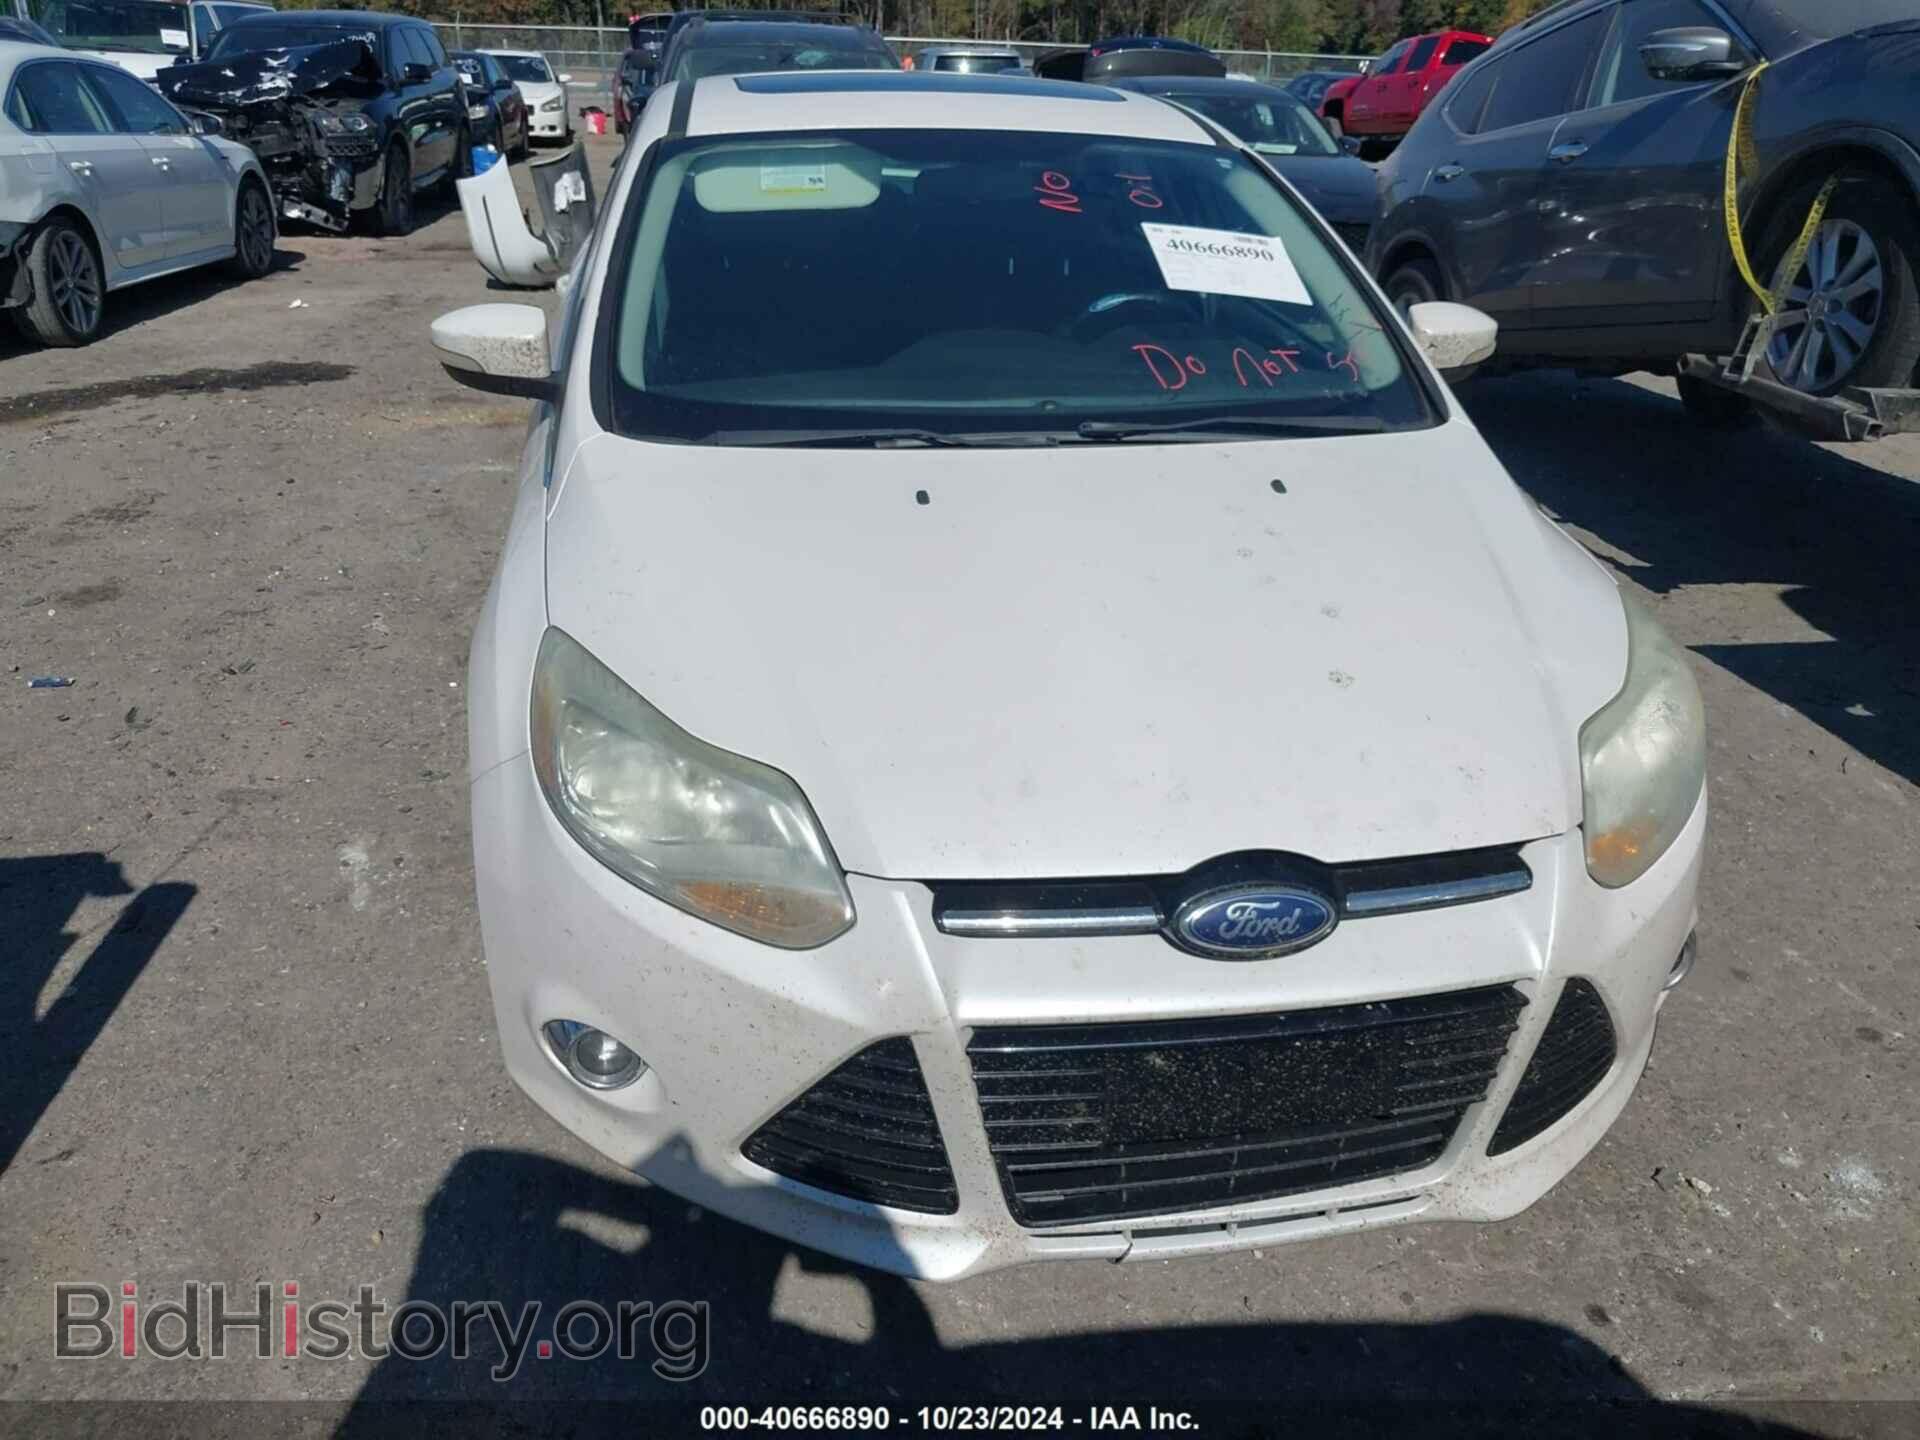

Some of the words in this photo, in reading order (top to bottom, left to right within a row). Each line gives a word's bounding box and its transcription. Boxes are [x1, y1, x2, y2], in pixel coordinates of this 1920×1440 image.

[1166, 238, 1275, 263] 40666890
[1131, 344, 1206, 390] Do
[1218, 901, 1302, 939] Ford
